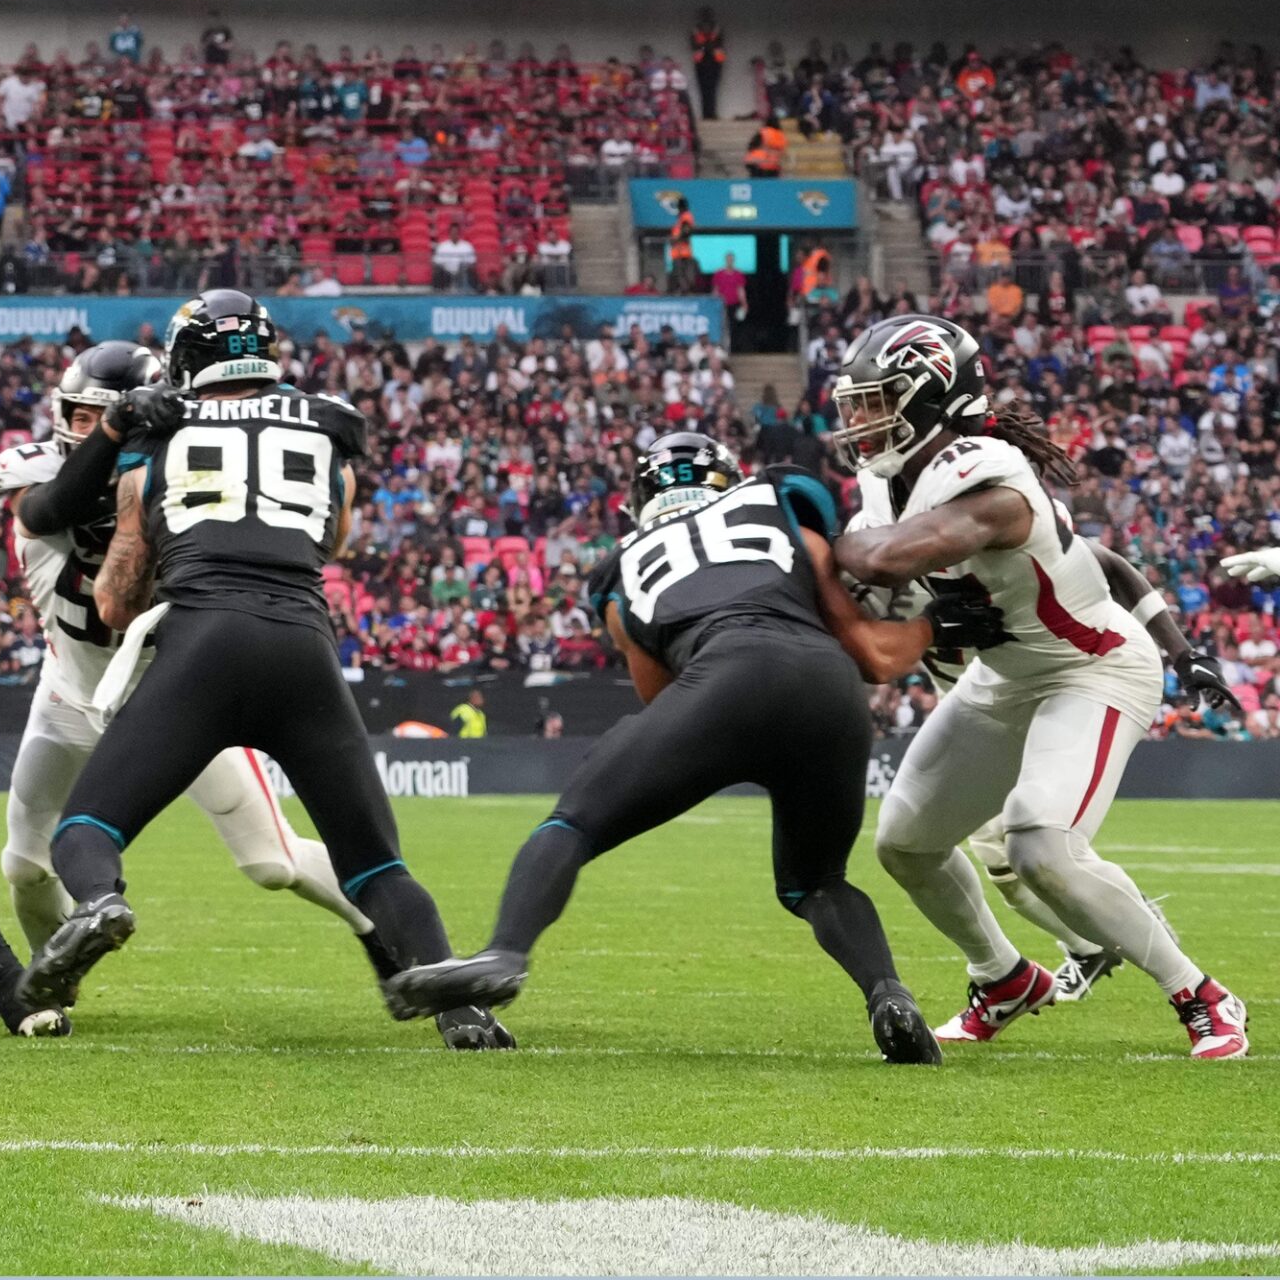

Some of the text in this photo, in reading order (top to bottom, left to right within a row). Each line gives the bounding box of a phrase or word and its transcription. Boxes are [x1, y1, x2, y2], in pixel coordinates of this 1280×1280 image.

[227, 334, 259, 354] 89
[220, 361, 270, 378] JAGUARS
[183, 393, 320, 428] FARRELL
[161, 426, 332, 543] 89
